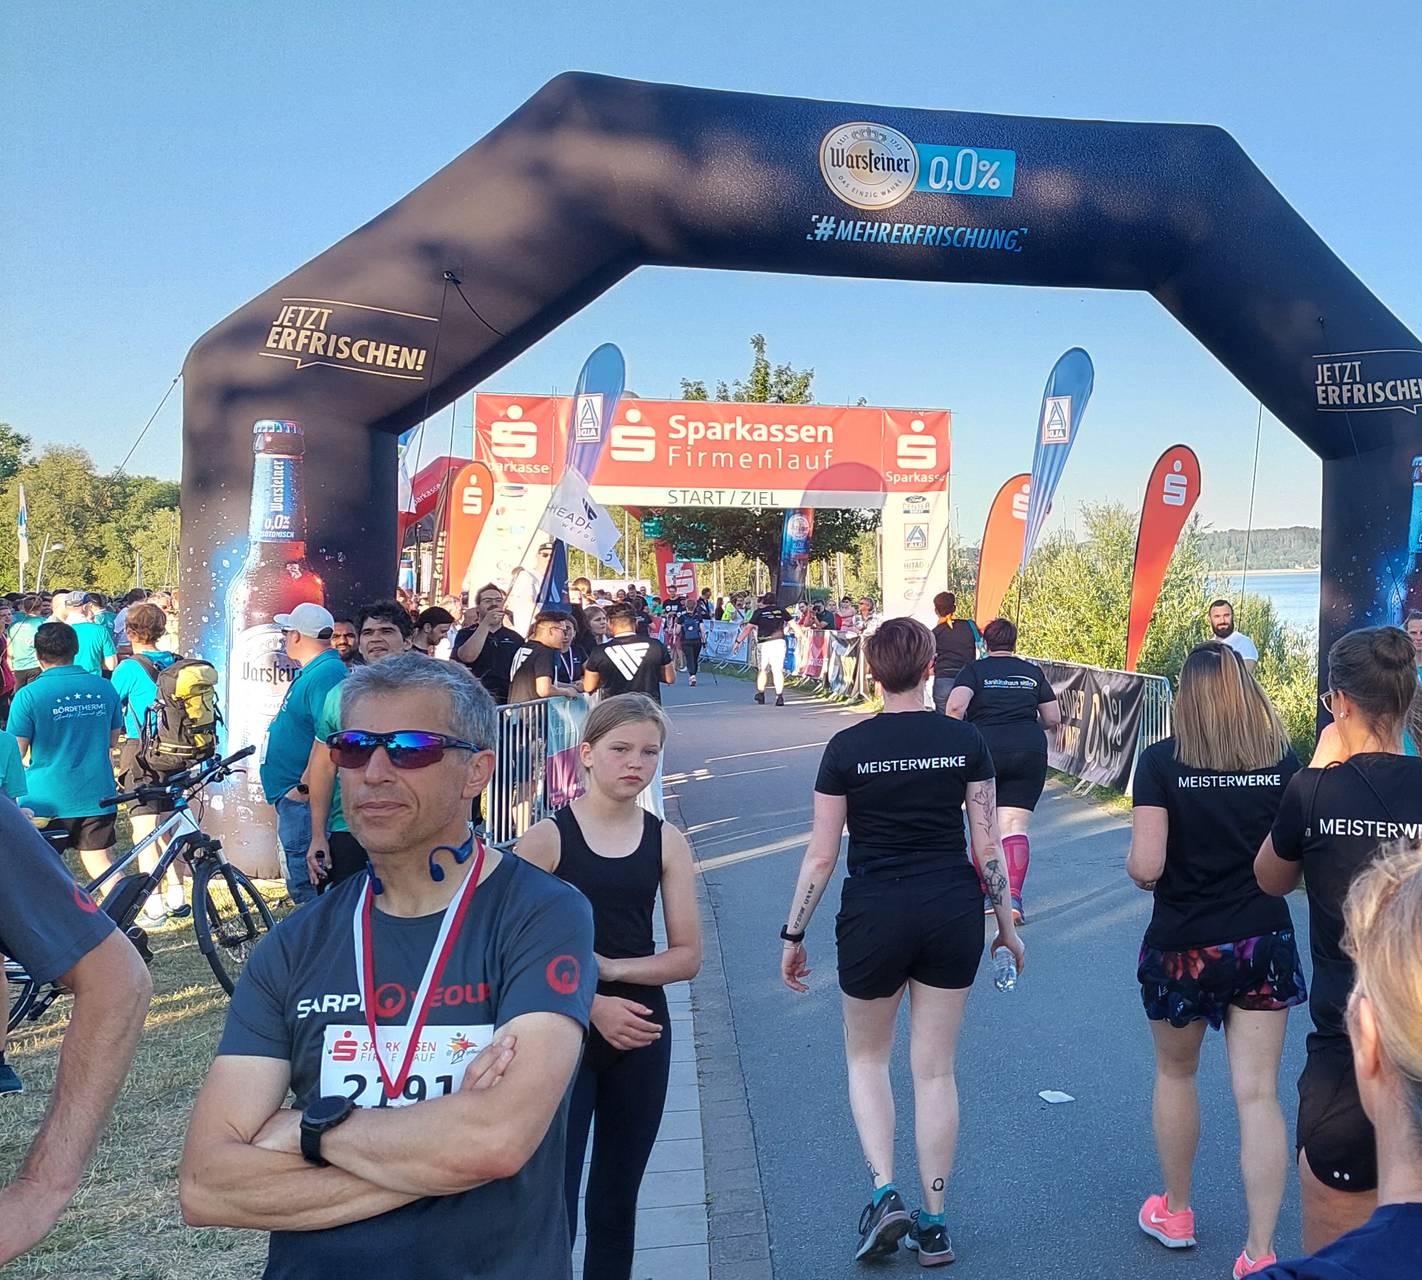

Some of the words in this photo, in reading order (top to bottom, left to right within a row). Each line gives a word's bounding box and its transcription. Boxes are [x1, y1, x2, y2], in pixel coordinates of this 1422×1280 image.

[829, 146, 911, 174] Warsteiner
[928, 149, 1001, 192] 0,0%
[813, 214, 1020, 251] #MEHRERFRISCHUNG
[272, 305, 333, 331] JETZT
[265, 326, 428, 371] ERFRISCHEN!
[1315, 361, 1361, 385] JETZT
[668, 414, 833, 446] Sparkassen
[668, 445, 833, 470] Firmenlauf
[270, 460, 285, 512] Warsteiner
[668, 489, 726, 506] START
[740, 491, 779, 506] ZIEL
[857, 755, 966, 774] MEISTERWERKE
[1178, 774, 1281, 788] MEISTERWERKE
